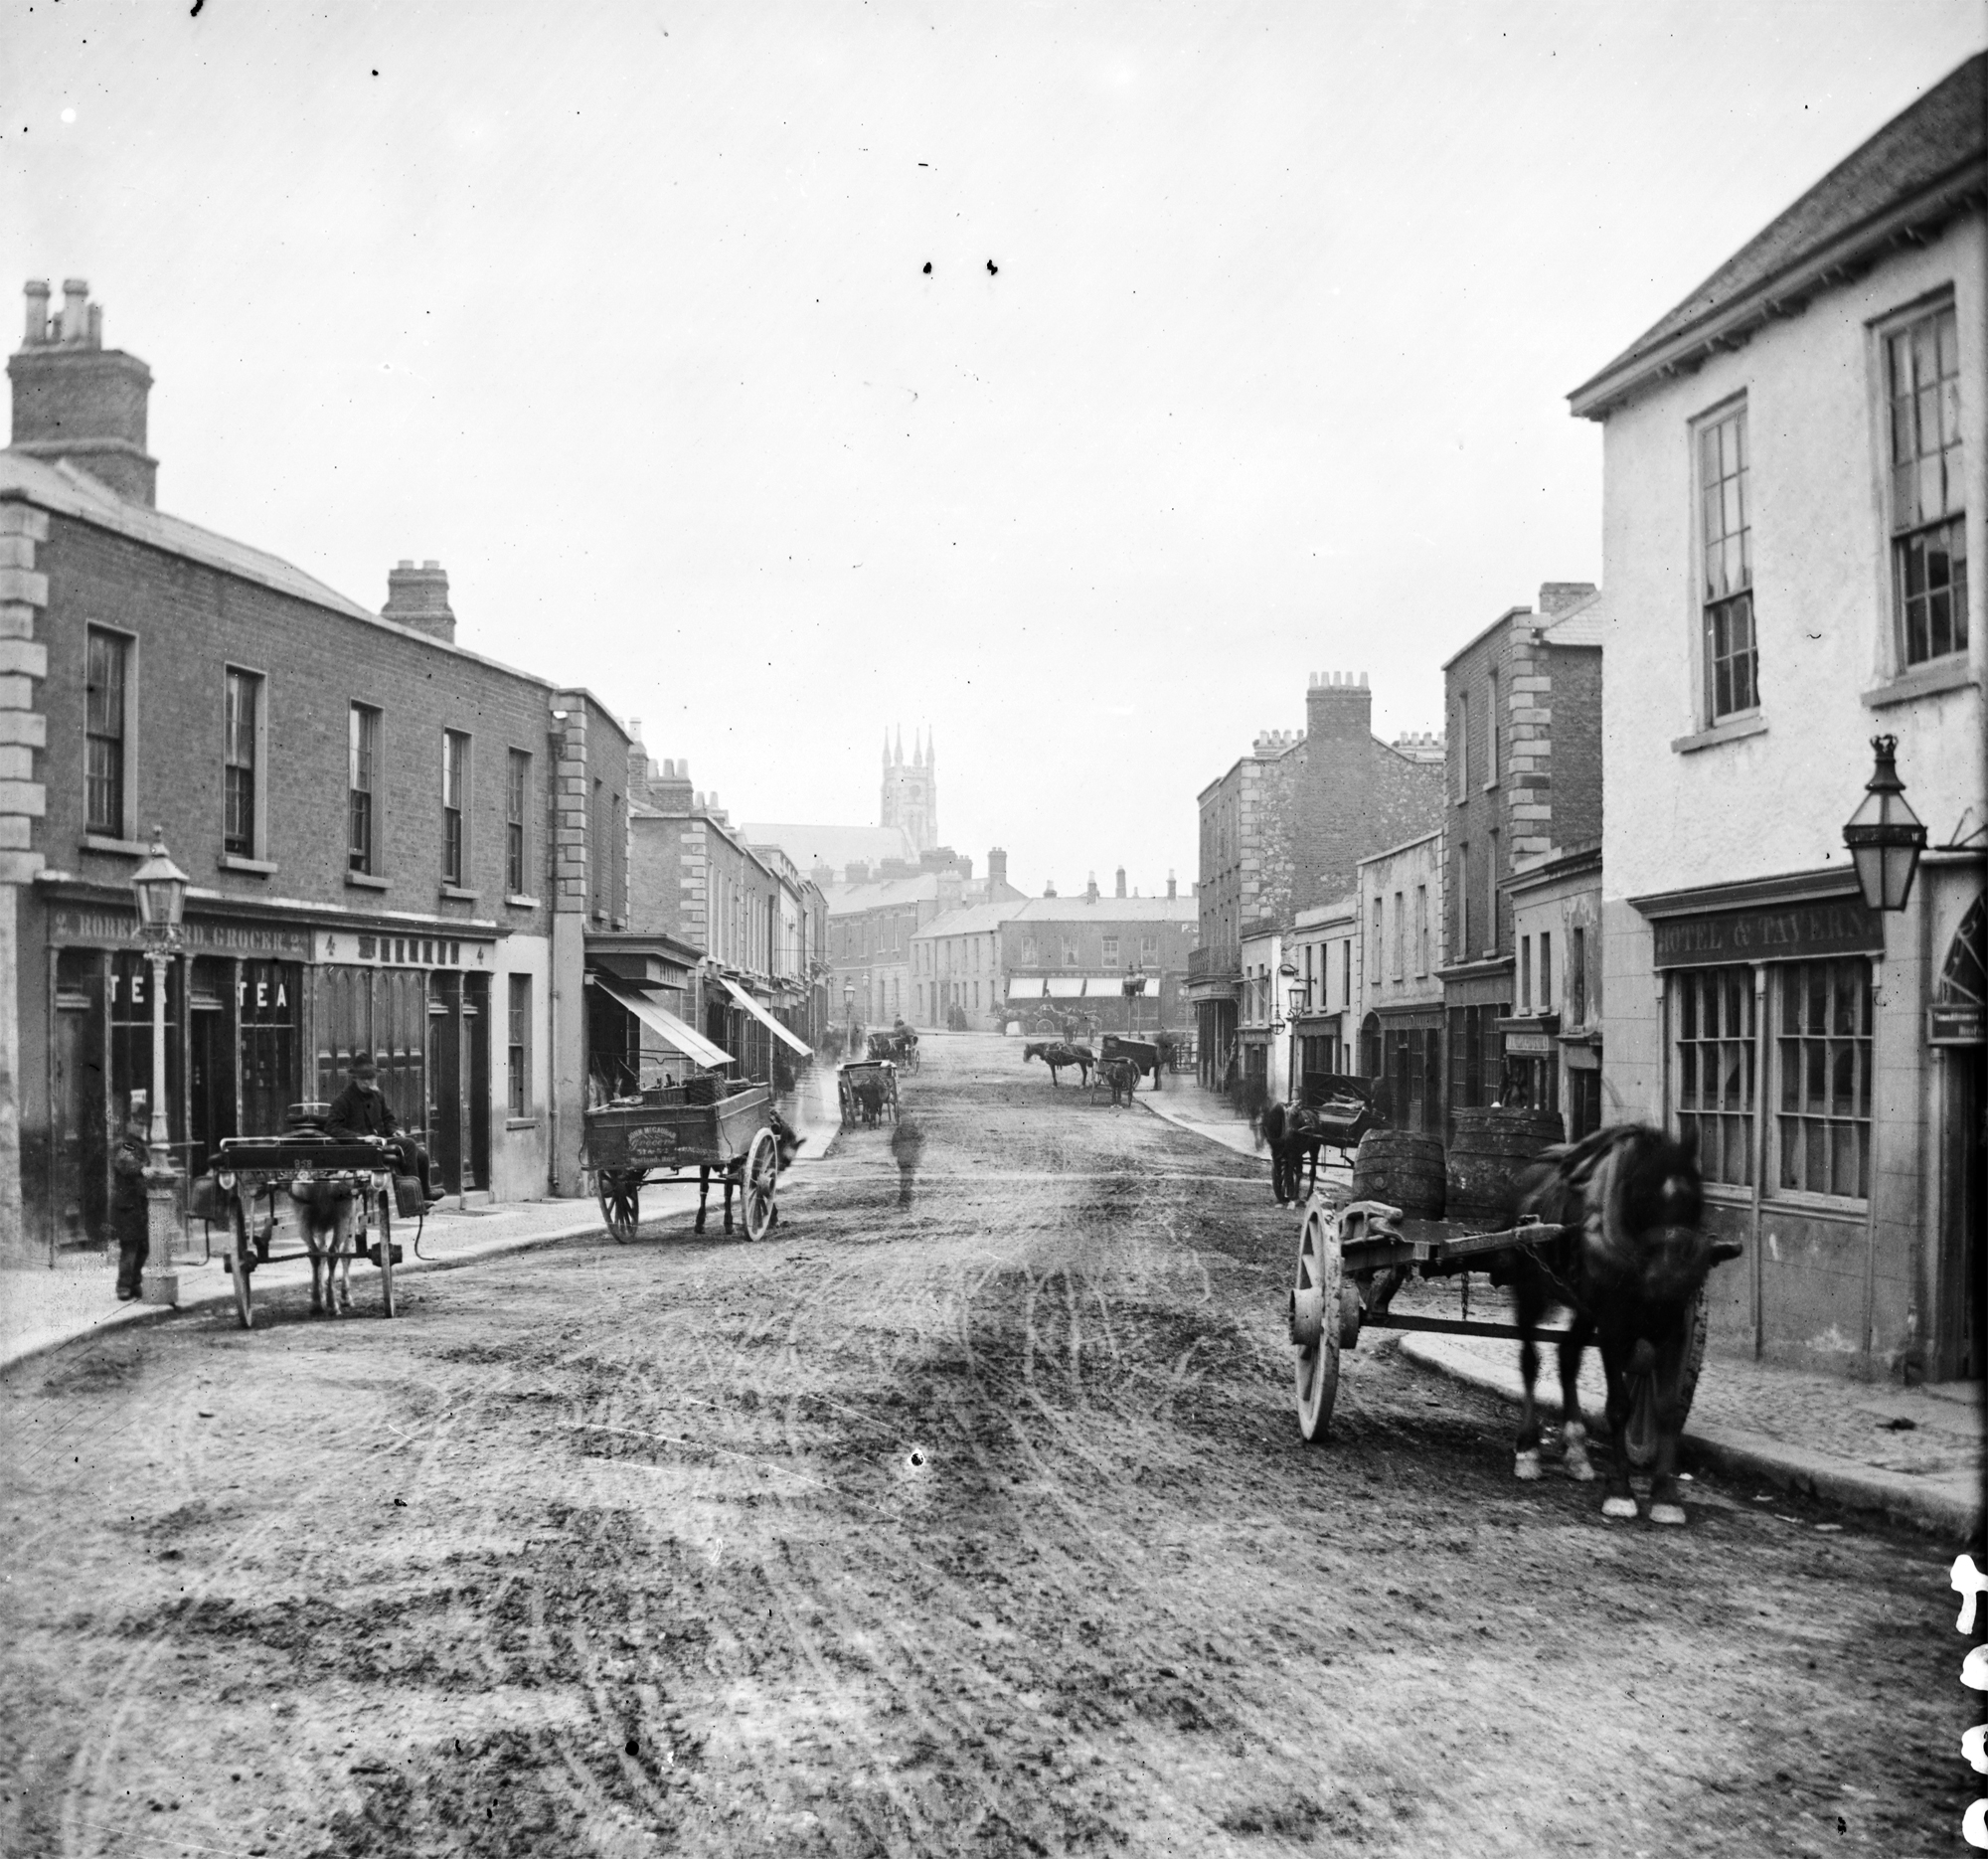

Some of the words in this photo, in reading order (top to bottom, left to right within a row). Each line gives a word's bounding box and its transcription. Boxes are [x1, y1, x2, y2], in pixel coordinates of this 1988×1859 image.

[1657, 922, 1722, 953] HOTEL
[1735, 918, 1749, 947] &
[110, 974, 167, 1003] TE
[240, 981, 287, 1007] TEA
[627, 1128, 643, 1142] JOHN
